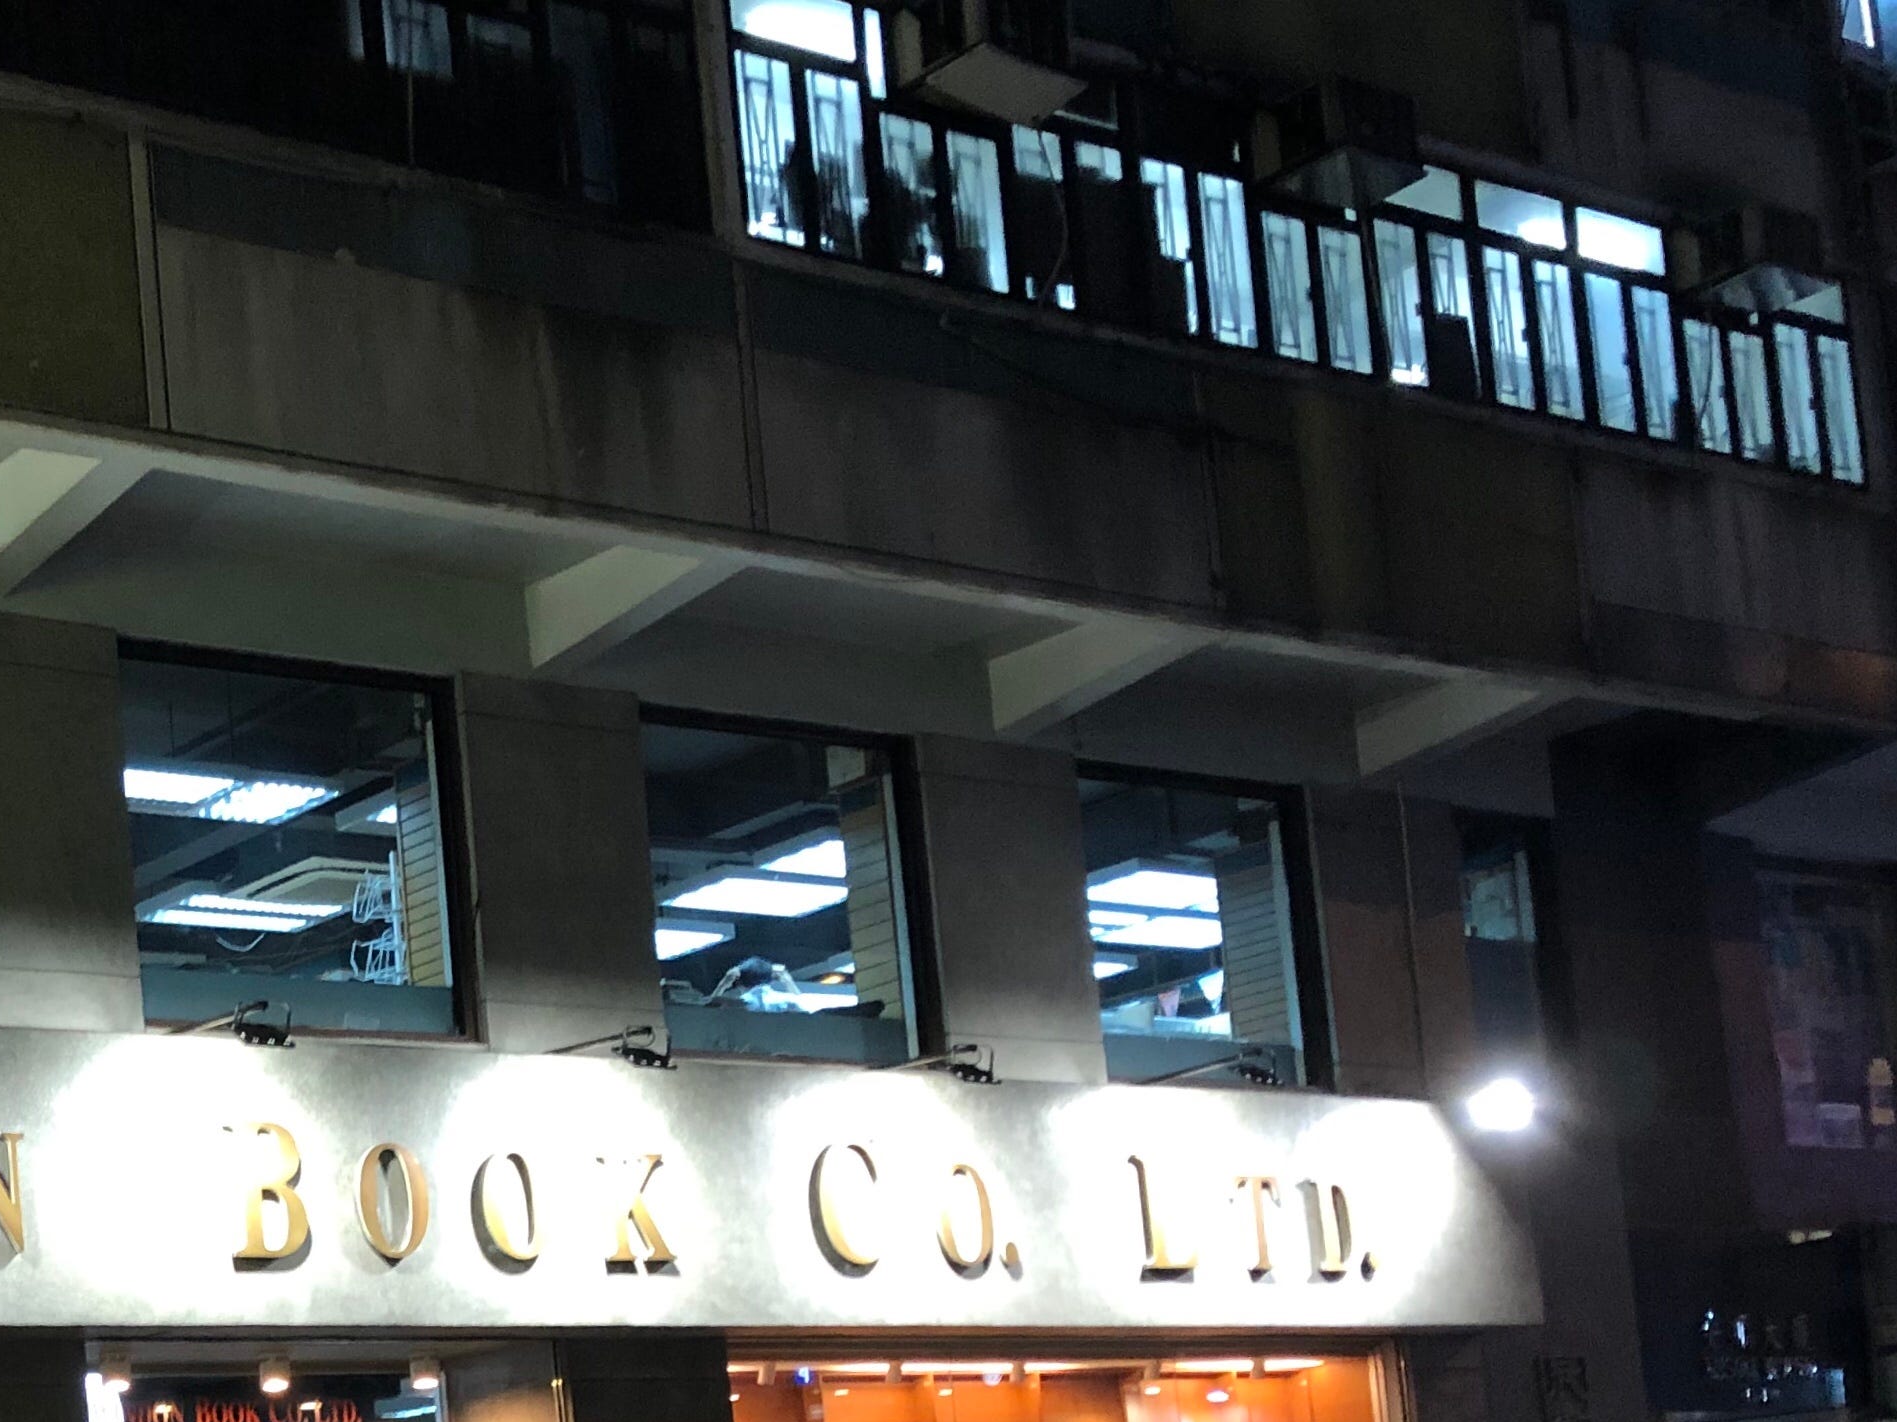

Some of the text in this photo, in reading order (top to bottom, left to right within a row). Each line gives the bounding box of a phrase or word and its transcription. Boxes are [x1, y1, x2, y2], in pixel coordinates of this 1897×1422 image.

[221, 1122, 682, 1277] BOOK
[808, 1143, 1024, 1282] CO.
[1126, 1154, 1382, 1284] LTD.
